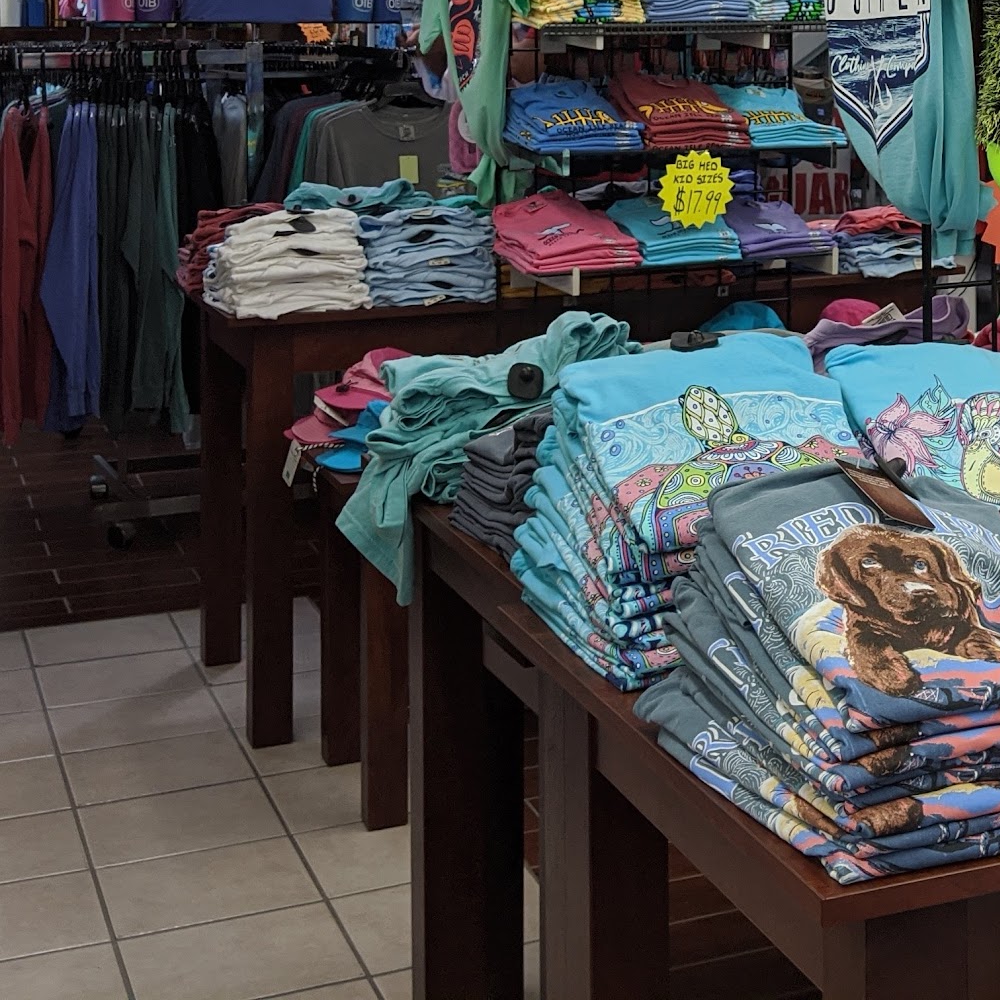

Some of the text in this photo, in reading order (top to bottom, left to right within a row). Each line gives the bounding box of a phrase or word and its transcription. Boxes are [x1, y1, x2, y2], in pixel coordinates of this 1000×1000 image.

[675, 159, 718, 171] BIG HED
[673, 173, 724, 185] KID SIZES
[673, 187, 723, 216] $17.99
